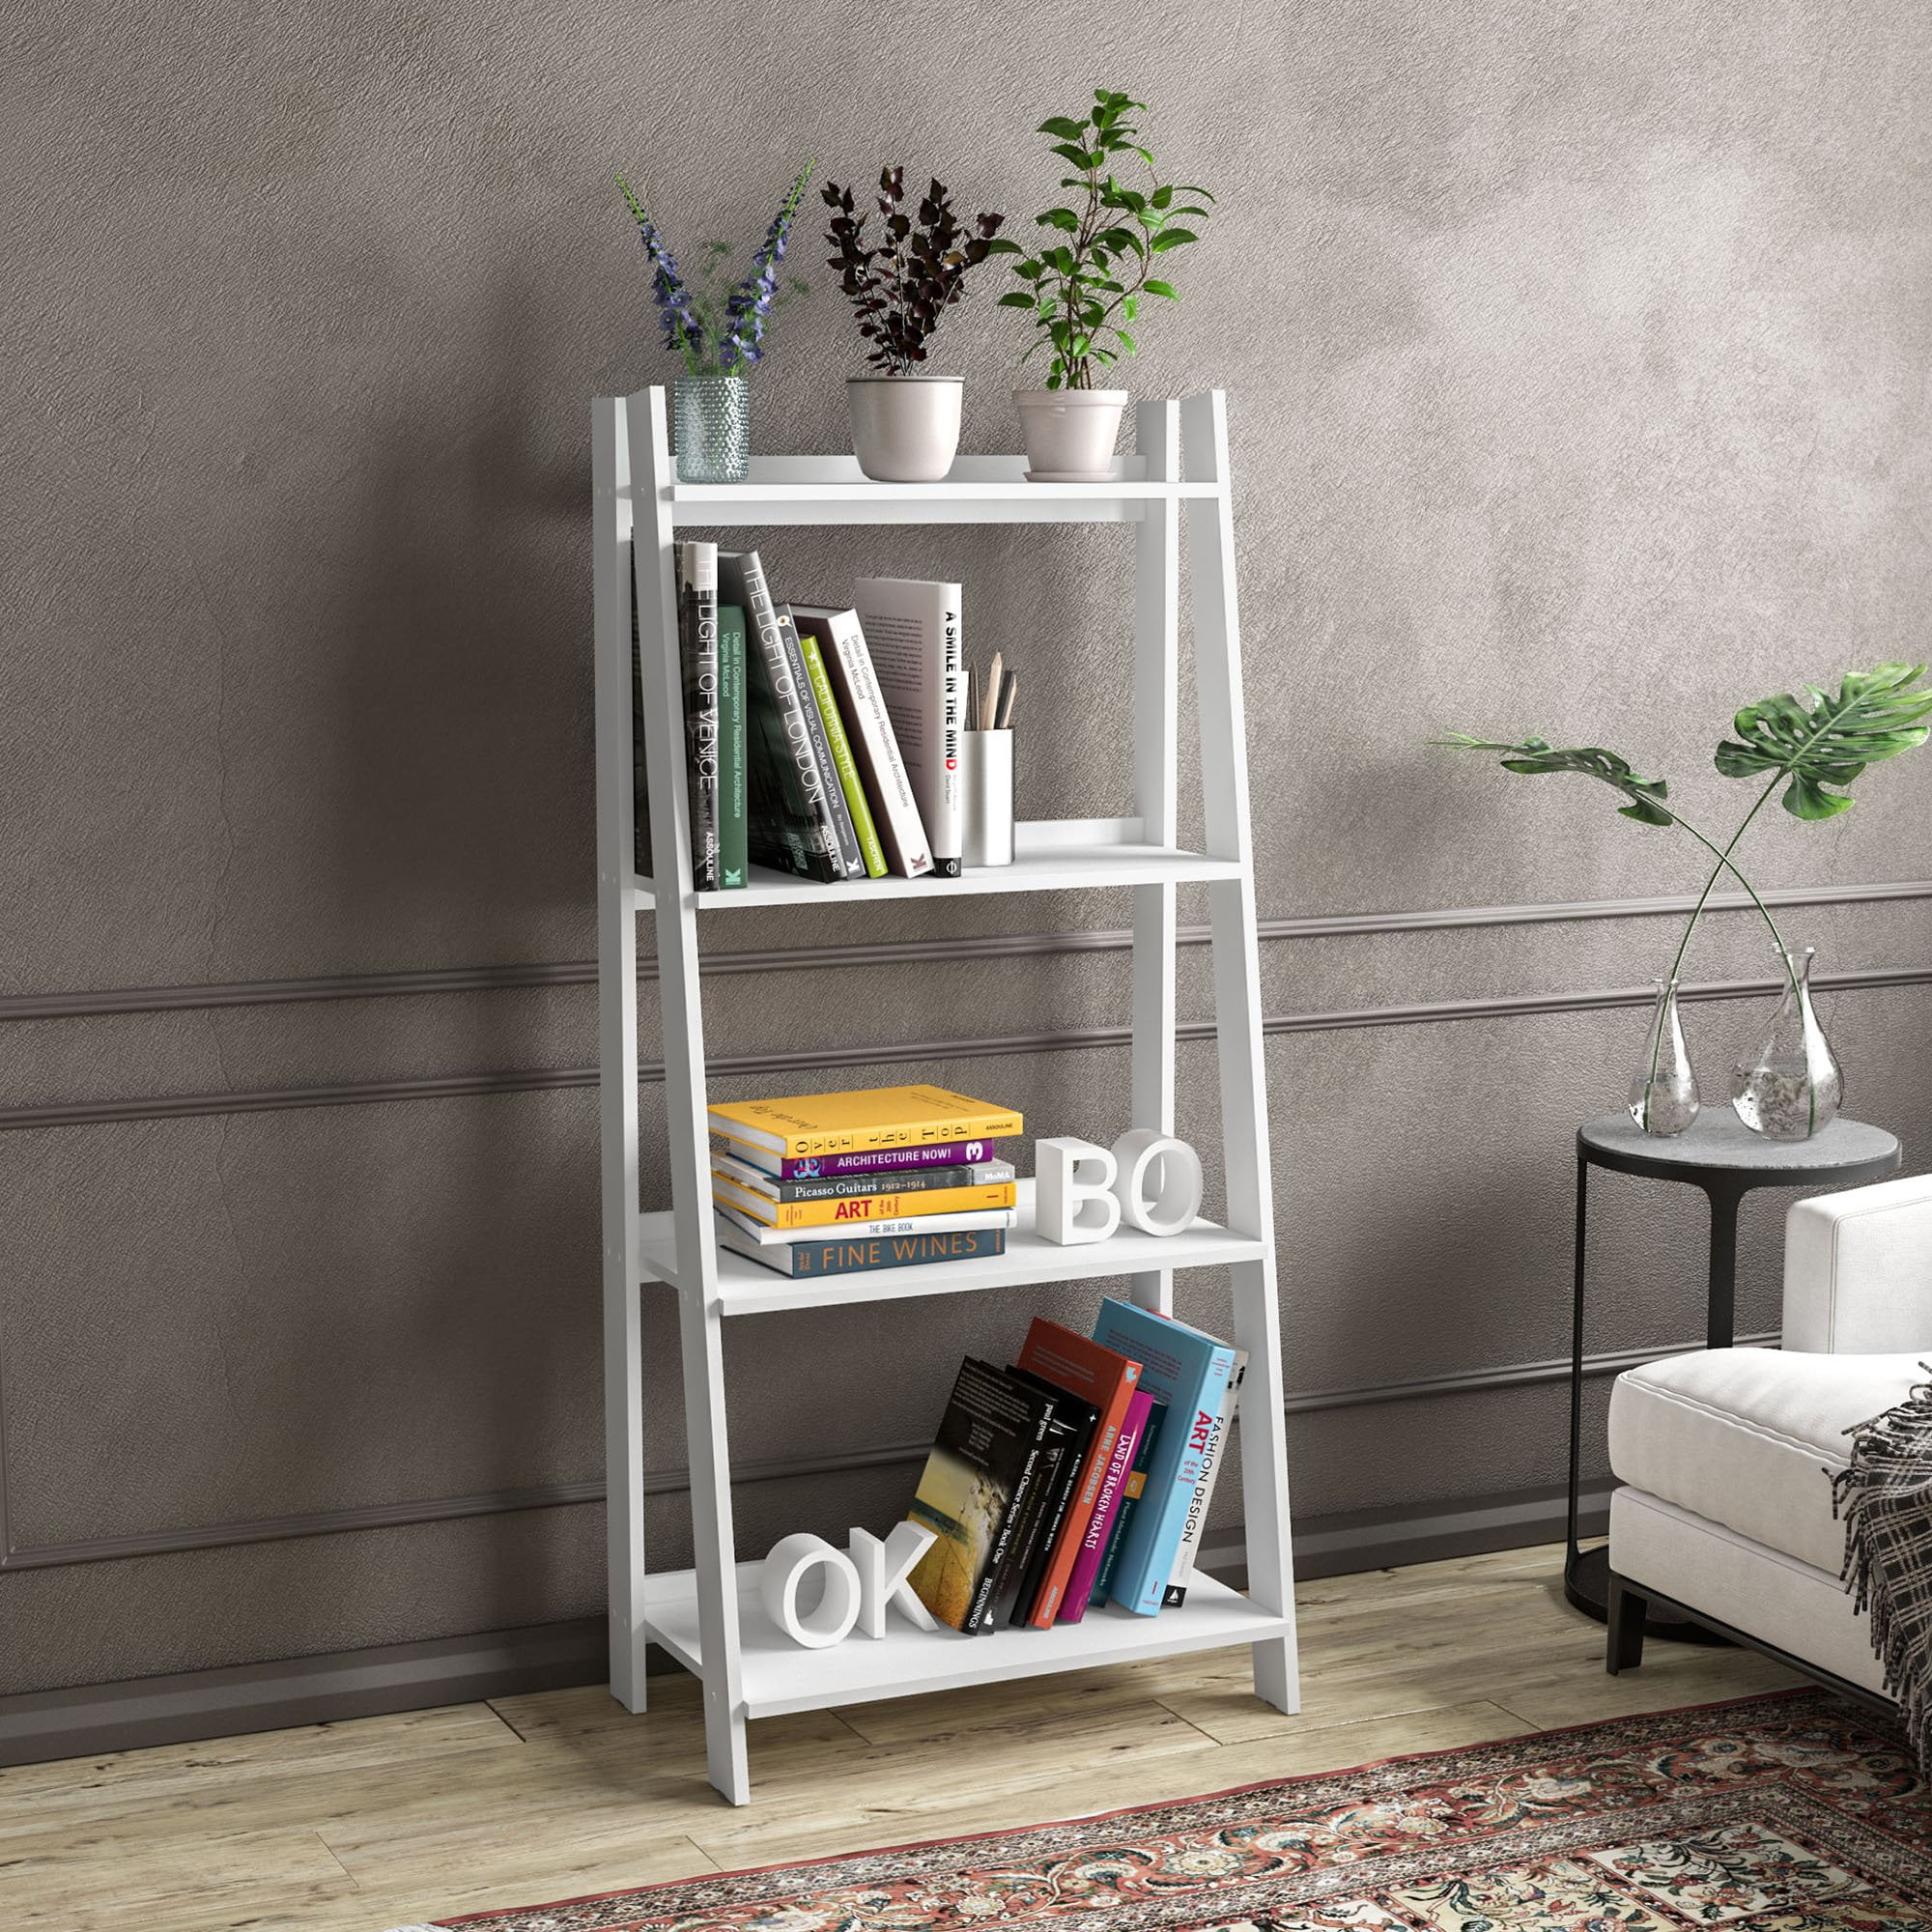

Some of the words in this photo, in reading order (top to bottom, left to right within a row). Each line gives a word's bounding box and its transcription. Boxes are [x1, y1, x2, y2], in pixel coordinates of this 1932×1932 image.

[698, 560, 718, 600] THE
[744, 567, 766, 611] THE
[946, 611, 957, 622] A
[698, 605, 718, 664] LIGHT
[721, 633, 729, 666] Virginia
[731, 632, 741, 656] Detail
[755, 610, 785, 670] LIGHT
[851, 634, 864, 658] Detail
[946, 627, 957, 672] SMILE
[784, 637, 806, 689] ESSENTIALS
[841, 639, 854, 669] Virginia
[850, 668, 866, 700] McLeod
[858, 657, 867, 666] in
[698, 673, 718, 704] OF
[730, 667, 741, 723] Contemporary
[775, 676, 799, 705] OF
[799, 689, 811, 704] OF
[861, 667, 883, 721] Contemporary
[946, 677, 957, 694] IN
[804, 701, 818, 735] VISUAL
[814, 675, 844, 743] CALIFORNIA
[836, 744, 855, 781] STYLE
[946, 697, 957, 724] THE
[699, 708, 718, 790] VENICE
[732, 724, 742, 769] Residential
[783, 708, 826, 804] LONDON
[877, 720, 896, 765] Residential
[945, 729, 958, 771] MIND
[812, 734, 840, 809] COMMUNICATION
[892, 763, 909, 808] Architecture
[733, 770, 742, 818] Architecture
[704, 832, 715, 882] ASSOULINE
[821, 825, 840, 872] ASSOULINE
[867, 837, 884, 872] TASCHEN
[795, 1138, 851, 1153] Over
[869, 1130, 908, 1144] the
[922, 1125, 968, 1140] Top
[838, 1151, 919, 1168] ARCHITECTURE
[922, 1148, 952, 1160] NOW!
[795, 1186, 835, 1198] Picasso
[836, 1183, 877, 1194] Guitars
[985, 1172, 1010, 1181] MoMA
[1036, 1128, 1204, 1246] BO
[835, 1200, 872, 1220] ART
[869, 1225, 880, 1234] THE
[882, 1224, 895, 1233] BIKE
[897, 1222, 914, 1233] BOOK
[822, 1242, 881, 1270] FINE
[892, 1231, 978, 1261] WINES
[1042, 1403, 1054, 1421] paul
[1036, 1420, 1048, 1441] green
[1114, 1435, 1131, 1461] LAND
[1188, 1410, 1213, 1455] ART
[1023, 1449, 1039, 1476] Second
[1198, 1416, 1224, 1483] FASHION
[1083, 1454, 1106, 1504] JACOBSEN
[1108, 1462, 1122, 1475] OF
[1177, 1475, 1196, 1485] Century
[1183, 1467, 1195, 1476] 20th
[1013, 1475, 1031, 1504] Chance
[1062, 1479, 1073, 1500] SEARCH
[1097, 1475, 1118, 1513] BROKEN
[1007, 1503, 1021, 1524] Series
[1084, 1513, 1106, 1549] HEARTS
[1181, 1487, 1206, 1543] DESIGN
[999, 1528, 1011, 1548] Book
[992, 1548, 1005, 1564] One
[761, 1520, 940, 1649] OK
[968, 1577, 993, 1629] BEGINNINGS
